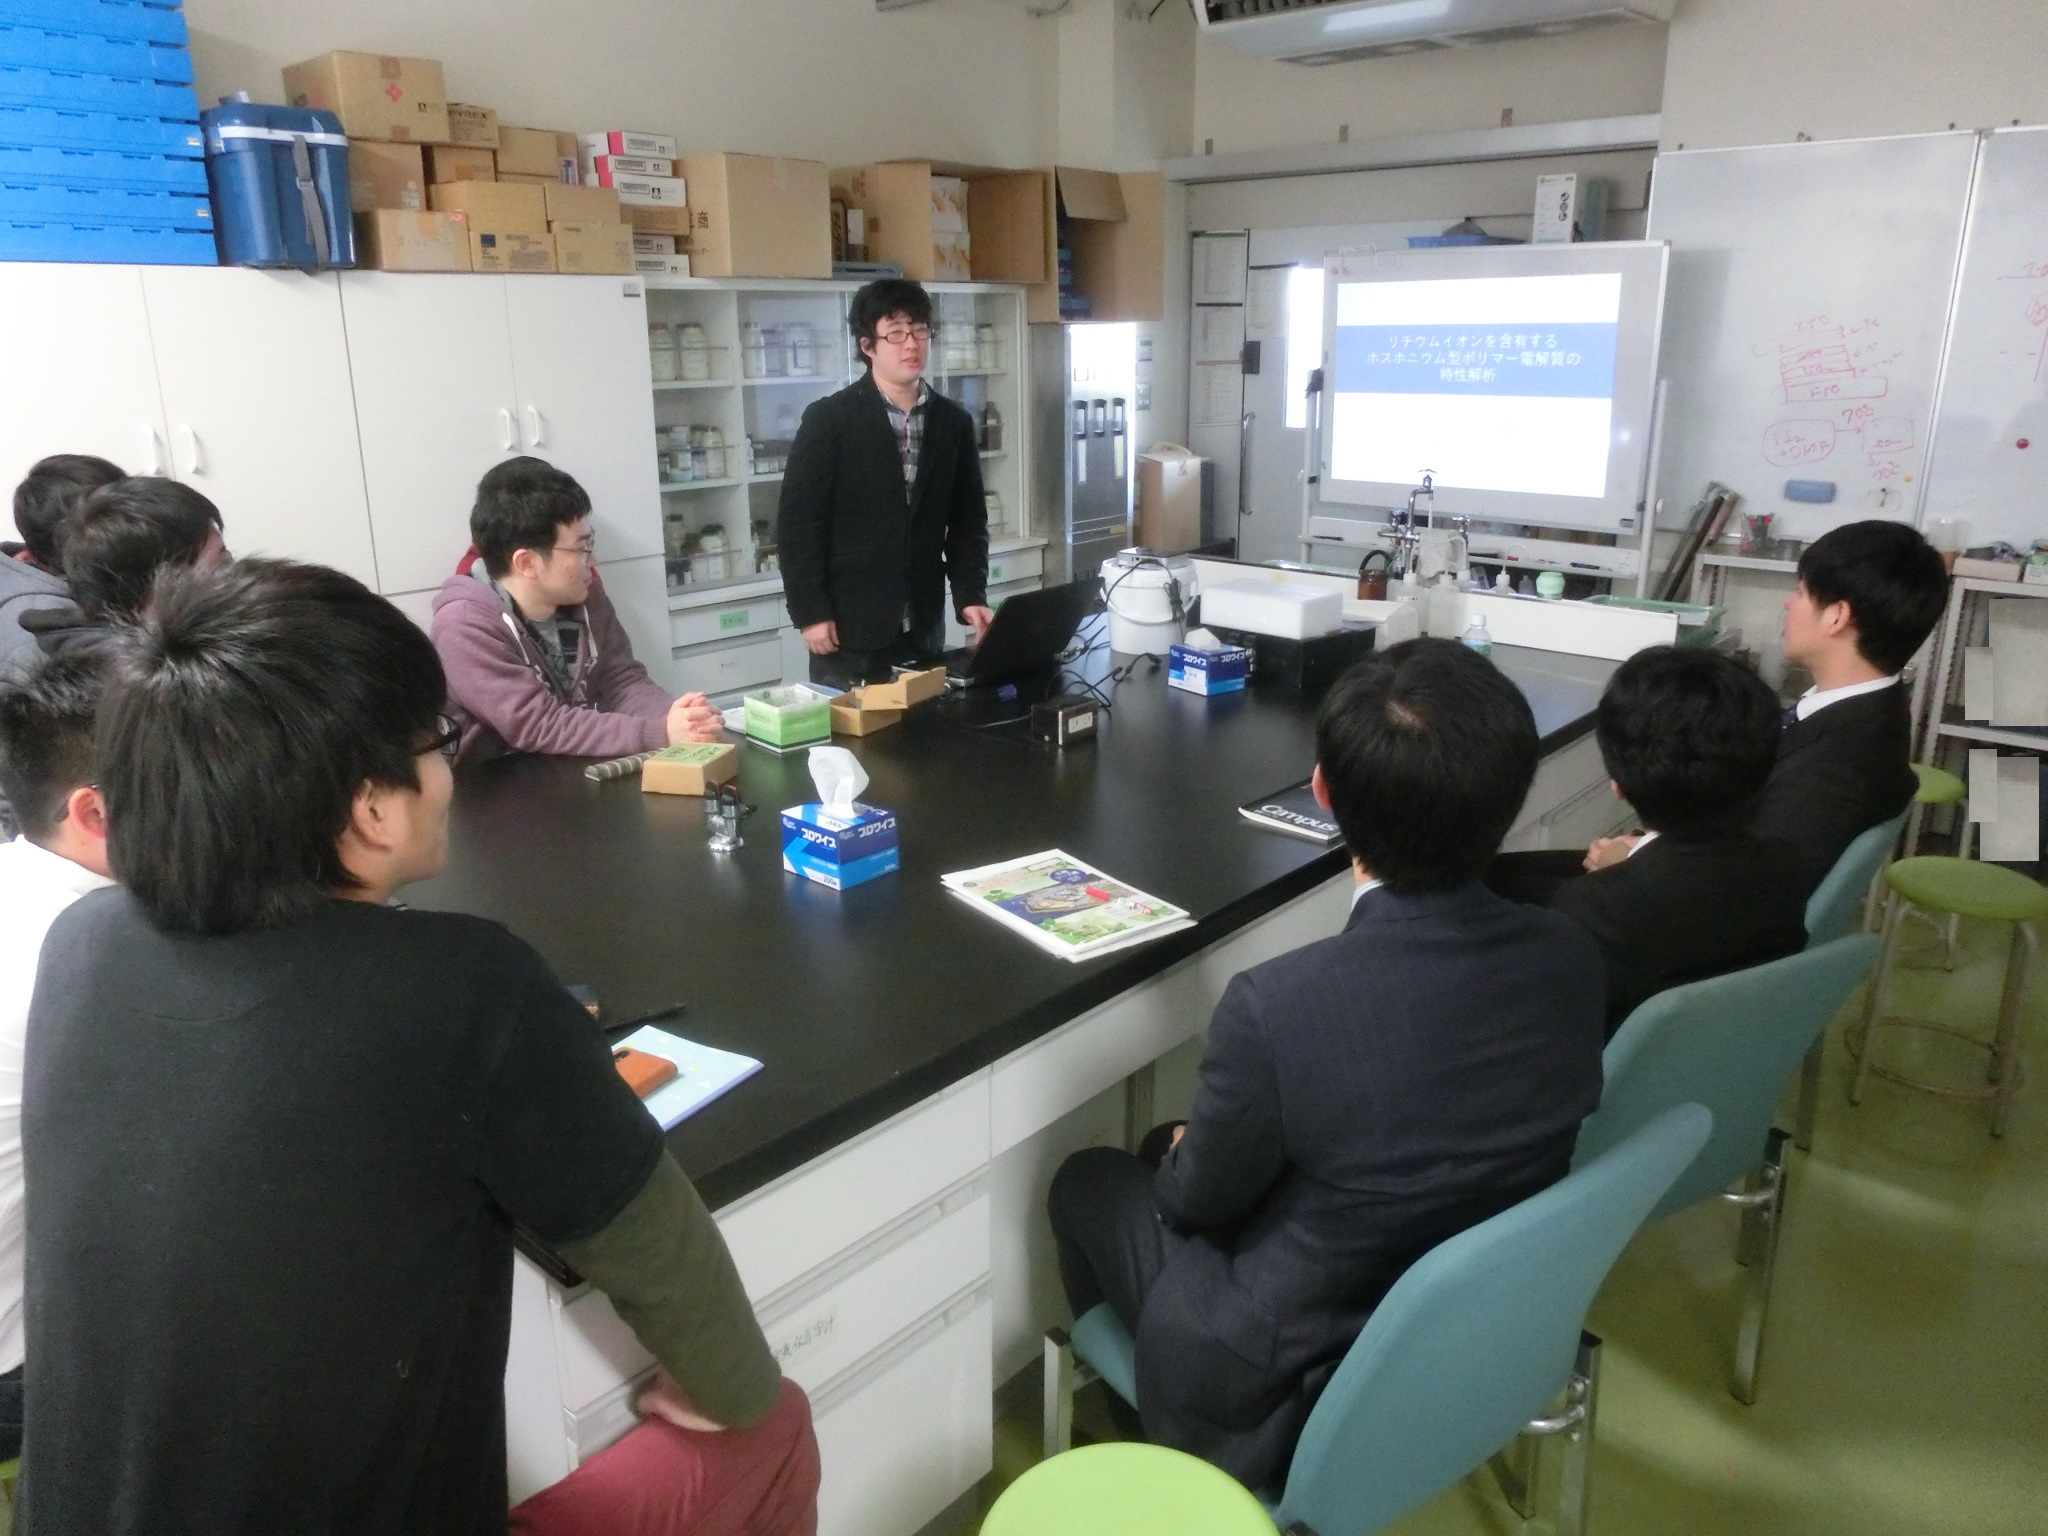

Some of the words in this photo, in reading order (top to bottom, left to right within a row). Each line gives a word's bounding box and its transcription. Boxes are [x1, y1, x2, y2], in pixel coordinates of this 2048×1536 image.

[1388, 333, 1558, 350] リチウムイオンを含有する
[1366, 350, 1582, 368] ホスホニウム型ポリマー電解質の
[1439, 367, 1497, 383] 特性解析
